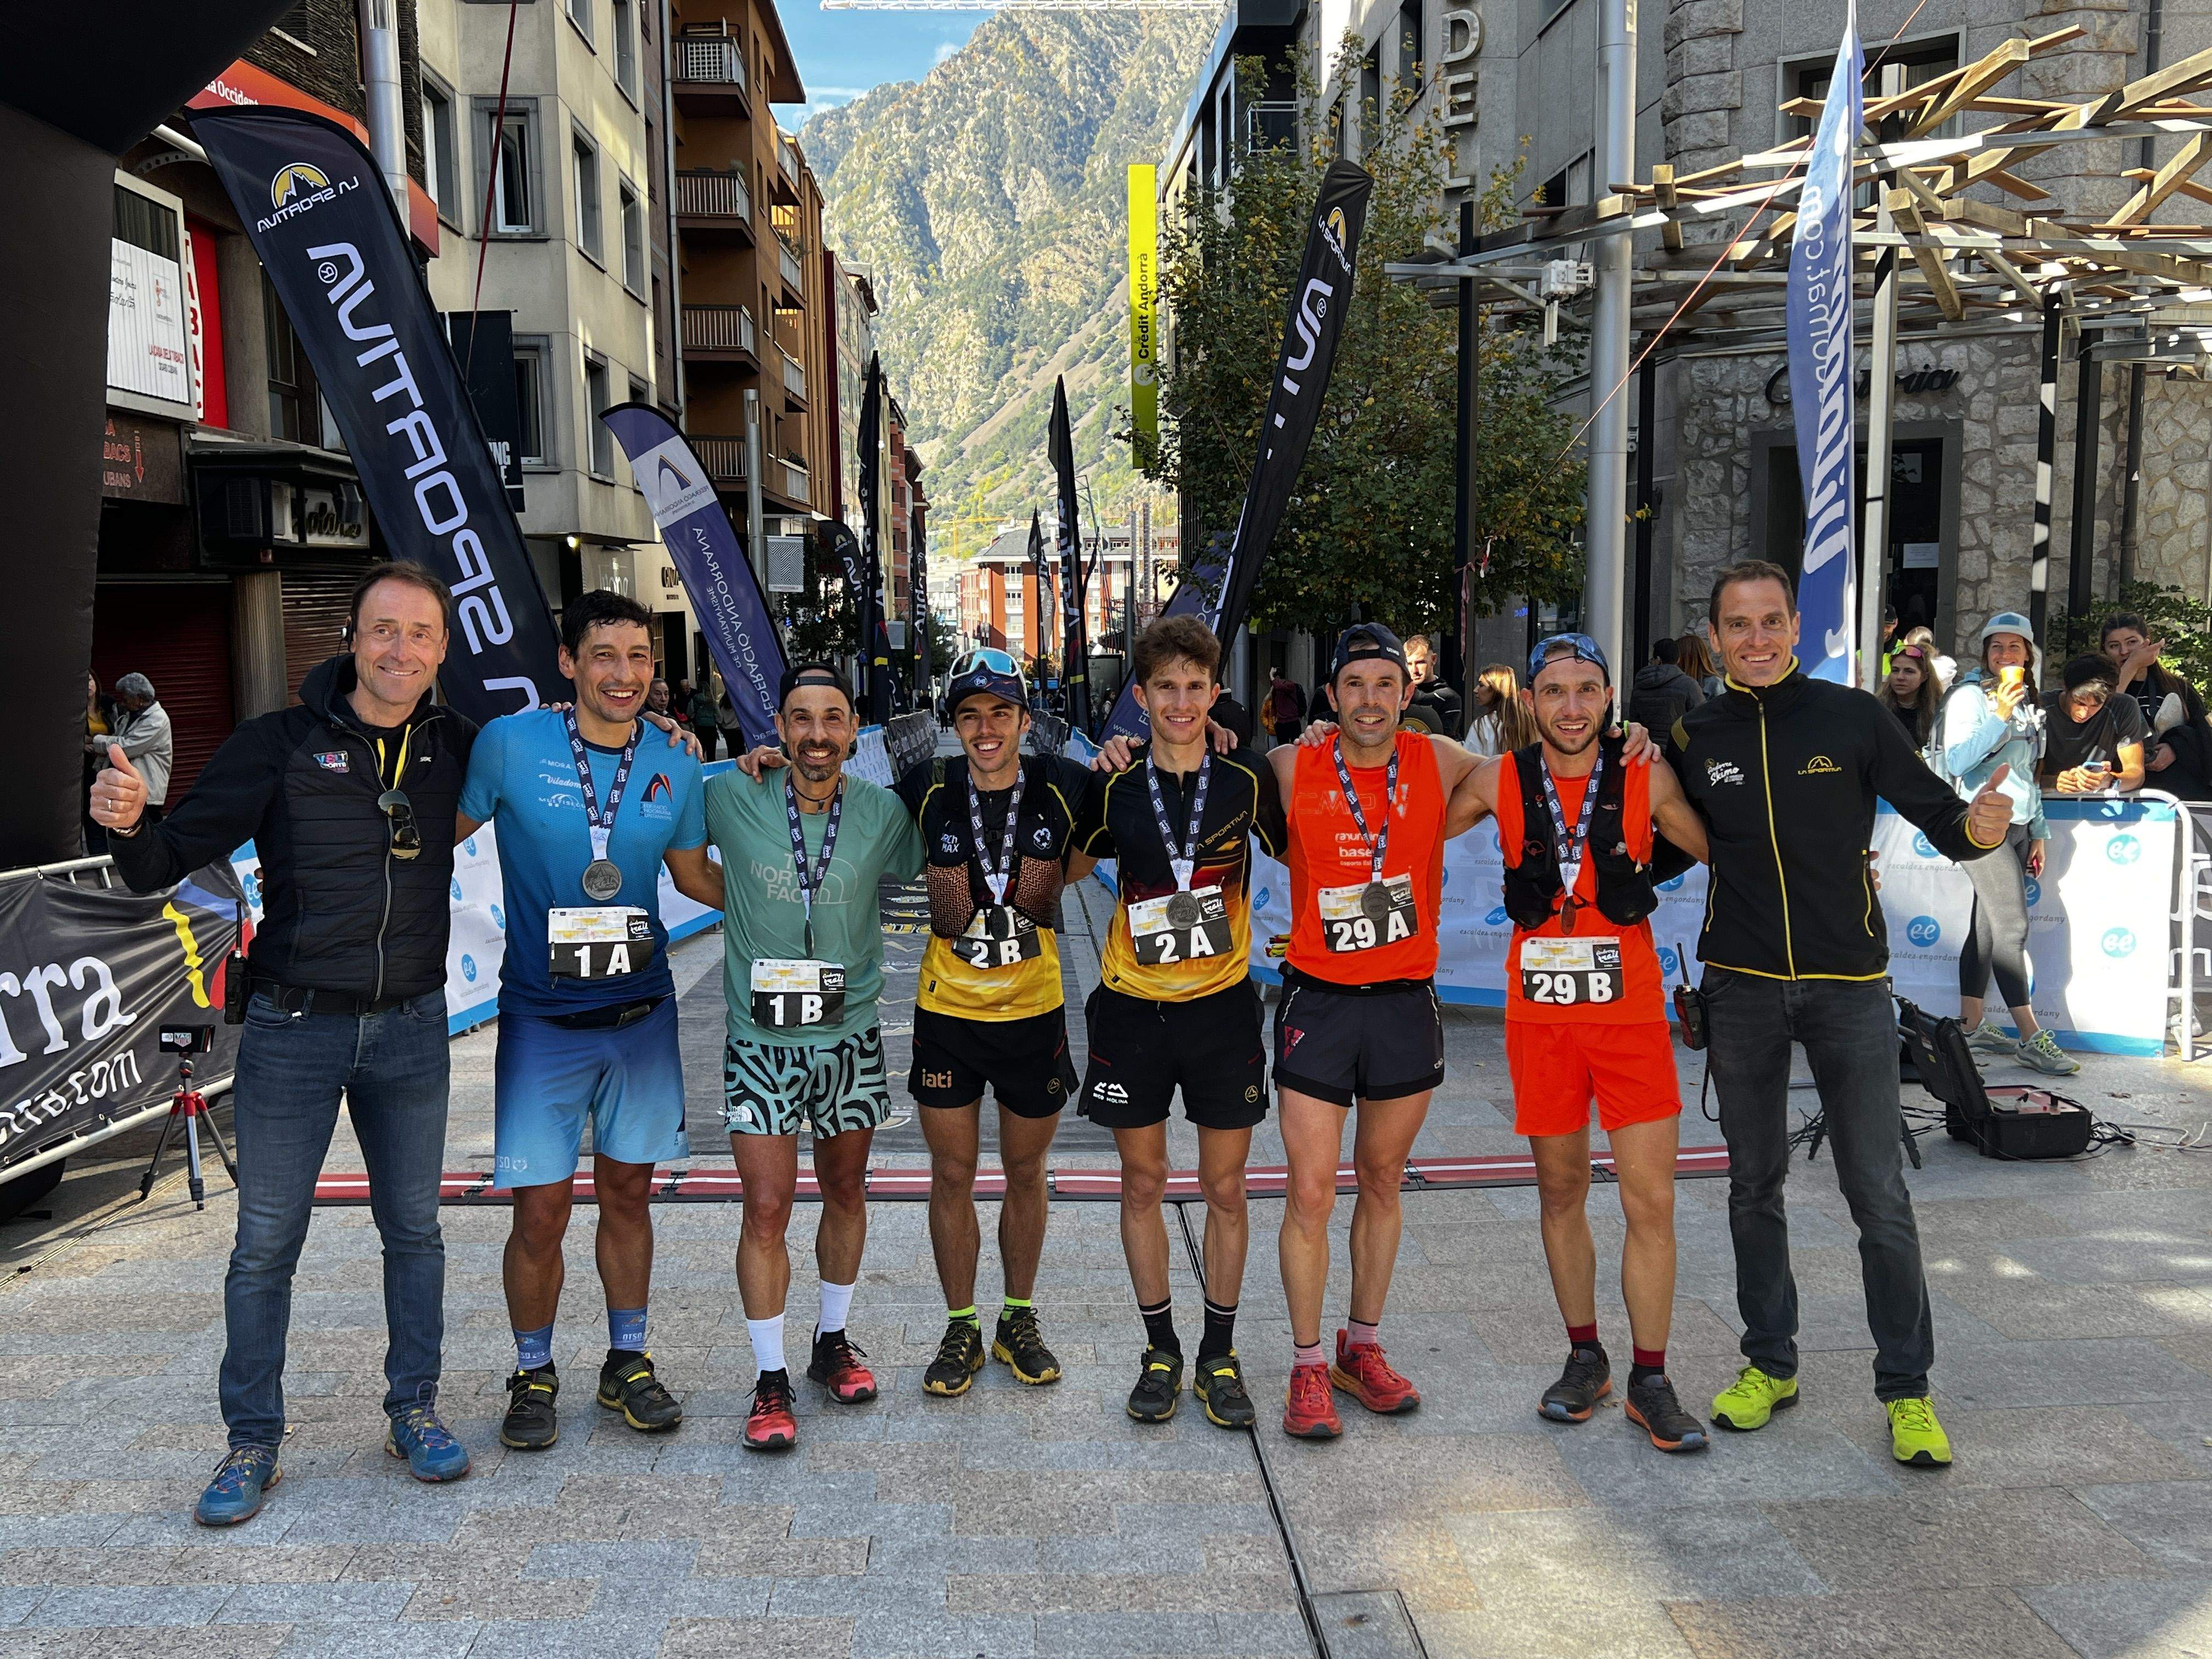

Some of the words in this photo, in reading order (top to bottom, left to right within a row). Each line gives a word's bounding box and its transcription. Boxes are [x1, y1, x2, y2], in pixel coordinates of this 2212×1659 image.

[1441, 9, 1485, 190] DEL
[1323, 231, 1351, 276] SPORTIVA
[103, 471, 132, 489] UBANS
[538, 774, 582, 789] Viladom
[1710, 766, 1740, 787] Skimo
[1205, 810, 1248, 844] SPORTIVA
[766, 883, 817, 904] FAC
[1155, 933, 1180, 964] 2
[1190, 925, 1215, 958] A
[1332, 918, 1376, 952] 29
[1387, 910, 1410, 943] A
[574, 945, 591, 977] 1
[606, 944, 631, 975] A
[969, 940, 989, 969] 2
[999, 939, 1022, 966] B
[1532, 973, 1577, 1005] 29
[1588, 972, 1613, 1003] B
[0, 956, 138, 1068] rra
[769, 995, 785, 1026] 1
[801, 994, 823, 1025] B
[922, 1068, 952, 1089] iati
